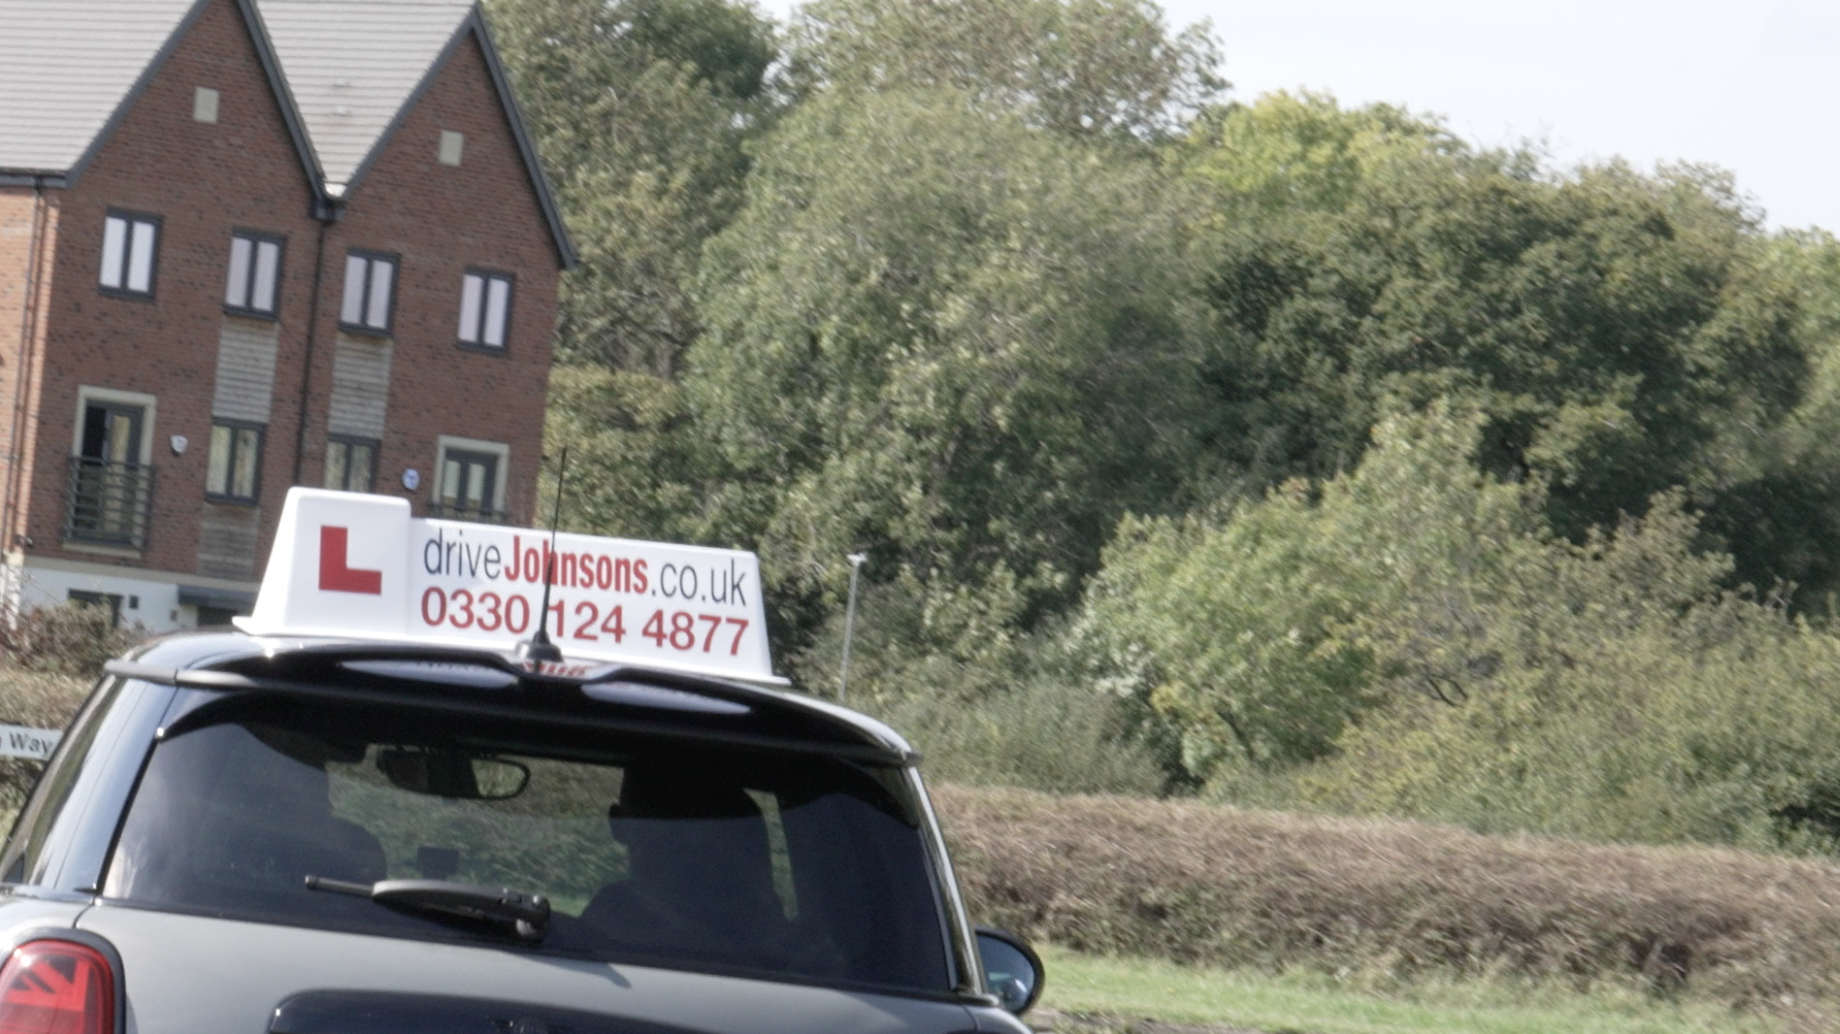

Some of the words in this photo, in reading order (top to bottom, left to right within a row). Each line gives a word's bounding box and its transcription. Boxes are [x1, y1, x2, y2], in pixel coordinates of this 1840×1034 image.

[318, 525, 382, 595] L
[423, 528, 748, 607] driveJohnsons.co.uk
[420, 586, 531, 634] 0330
[549, 599, 627, 643] 124
[642, 611, 750, 657] 4877
[10, 732, 54, 756] Way
